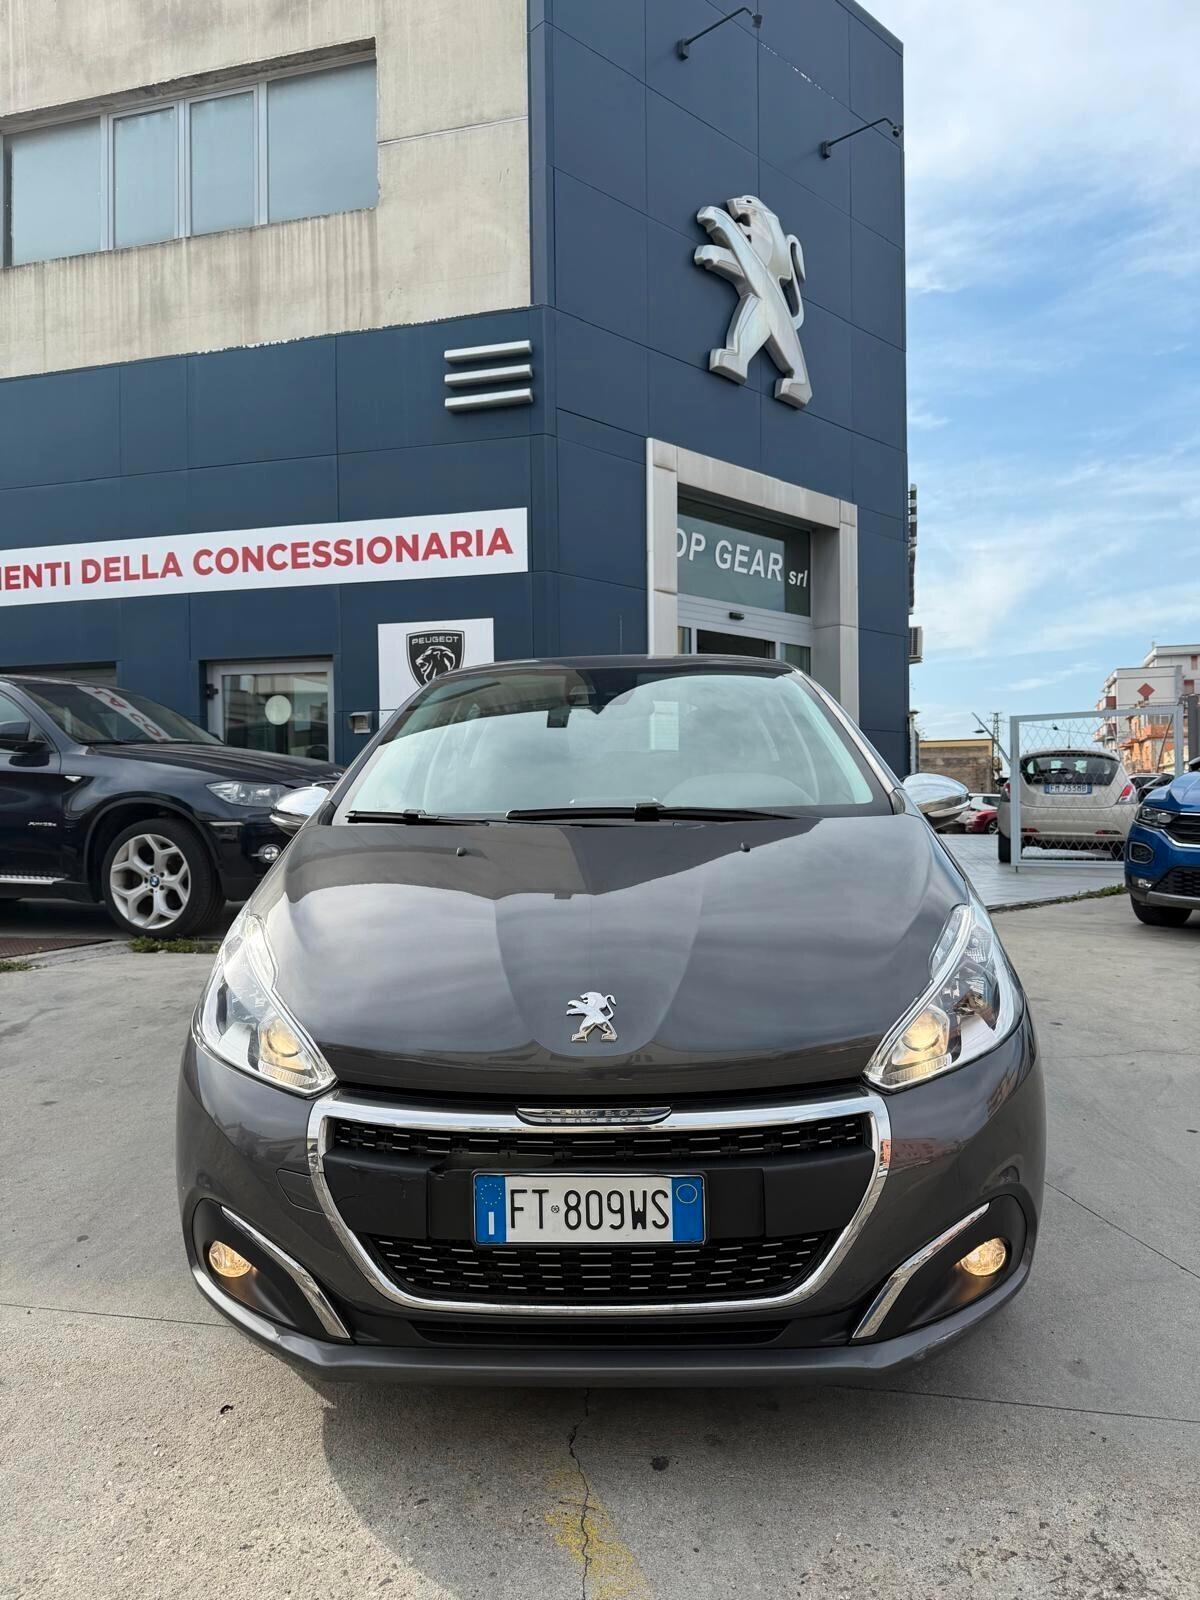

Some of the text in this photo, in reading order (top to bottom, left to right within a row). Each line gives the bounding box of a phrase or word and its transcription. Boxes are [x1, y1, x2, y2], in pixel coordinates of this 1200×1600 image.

[0, 527, 513, 591] ENTI DELLA CONCESSIONARIA
[715, 540, 784, 581] GEAR
[788, 570, 808, 587] srl
[412, 636, 459, 645] PEUGEOT
